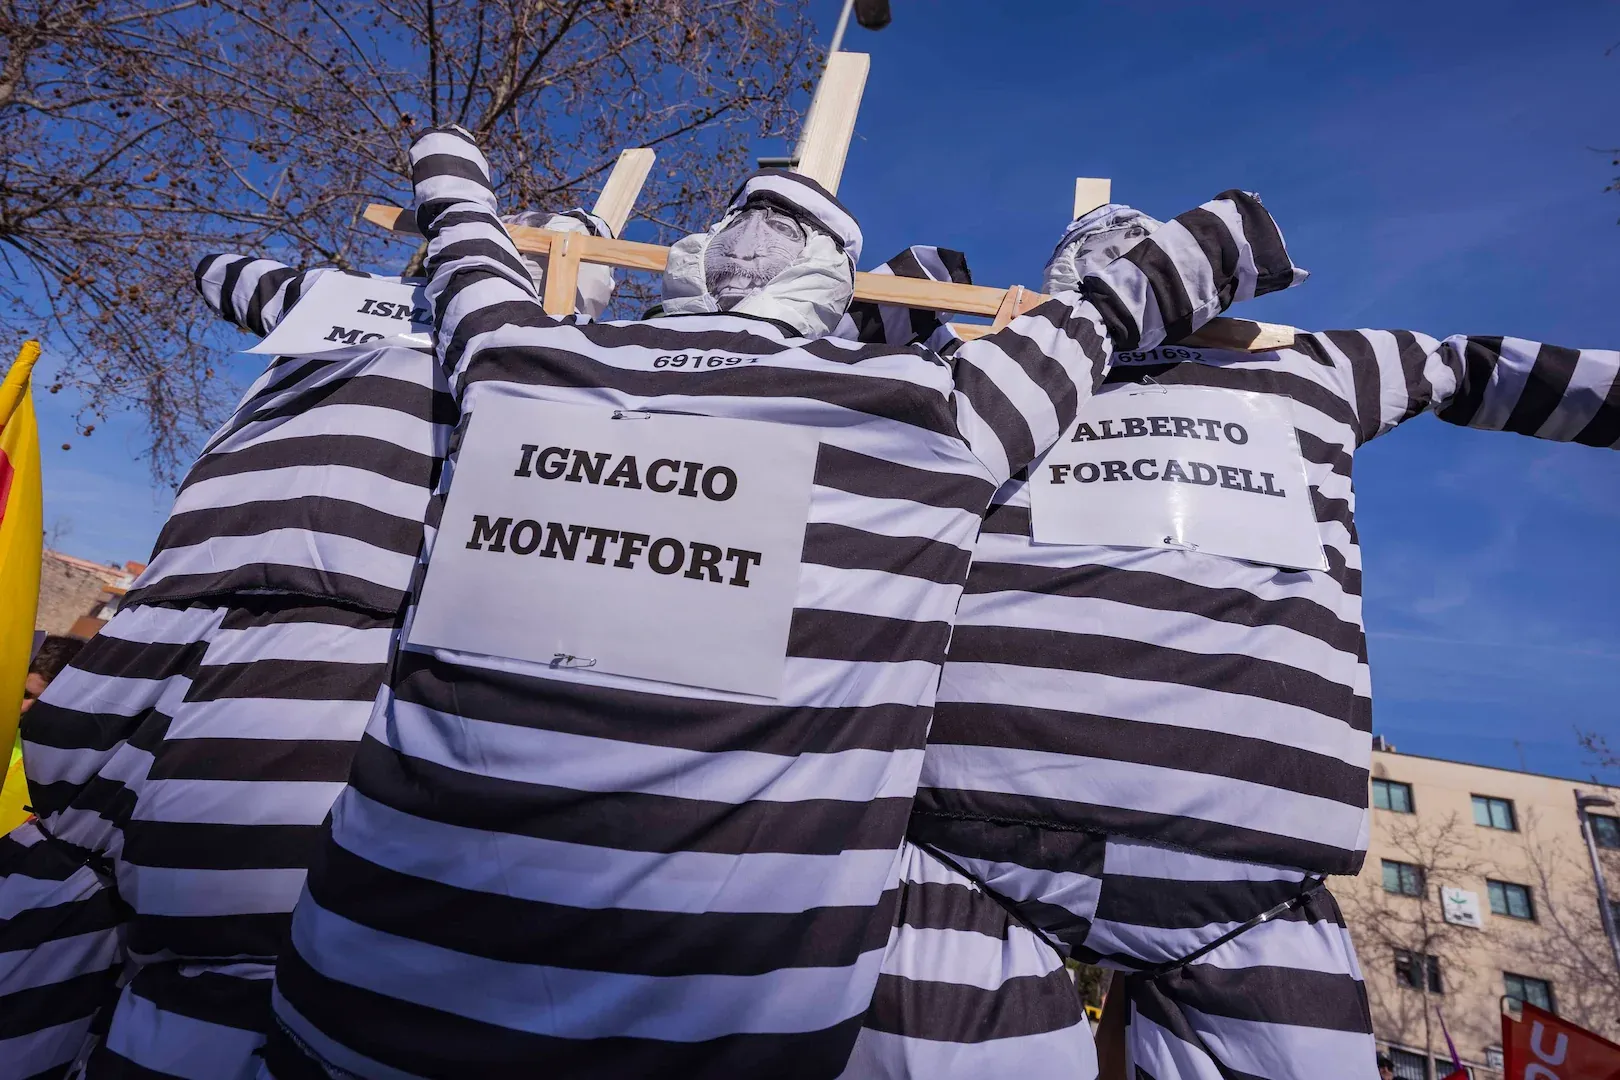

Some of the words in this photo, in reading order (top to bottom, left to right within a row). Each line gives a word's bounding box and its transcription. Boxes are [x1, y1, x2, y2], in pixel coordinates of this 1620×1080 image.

[1071, 416, 1249, 445] ALBERTO
[514, 444, 738, 501] IGNACIO
[1049, 459, 1286, 498] FORCADELL
[465, 515, 762, 588] MONTFORT
